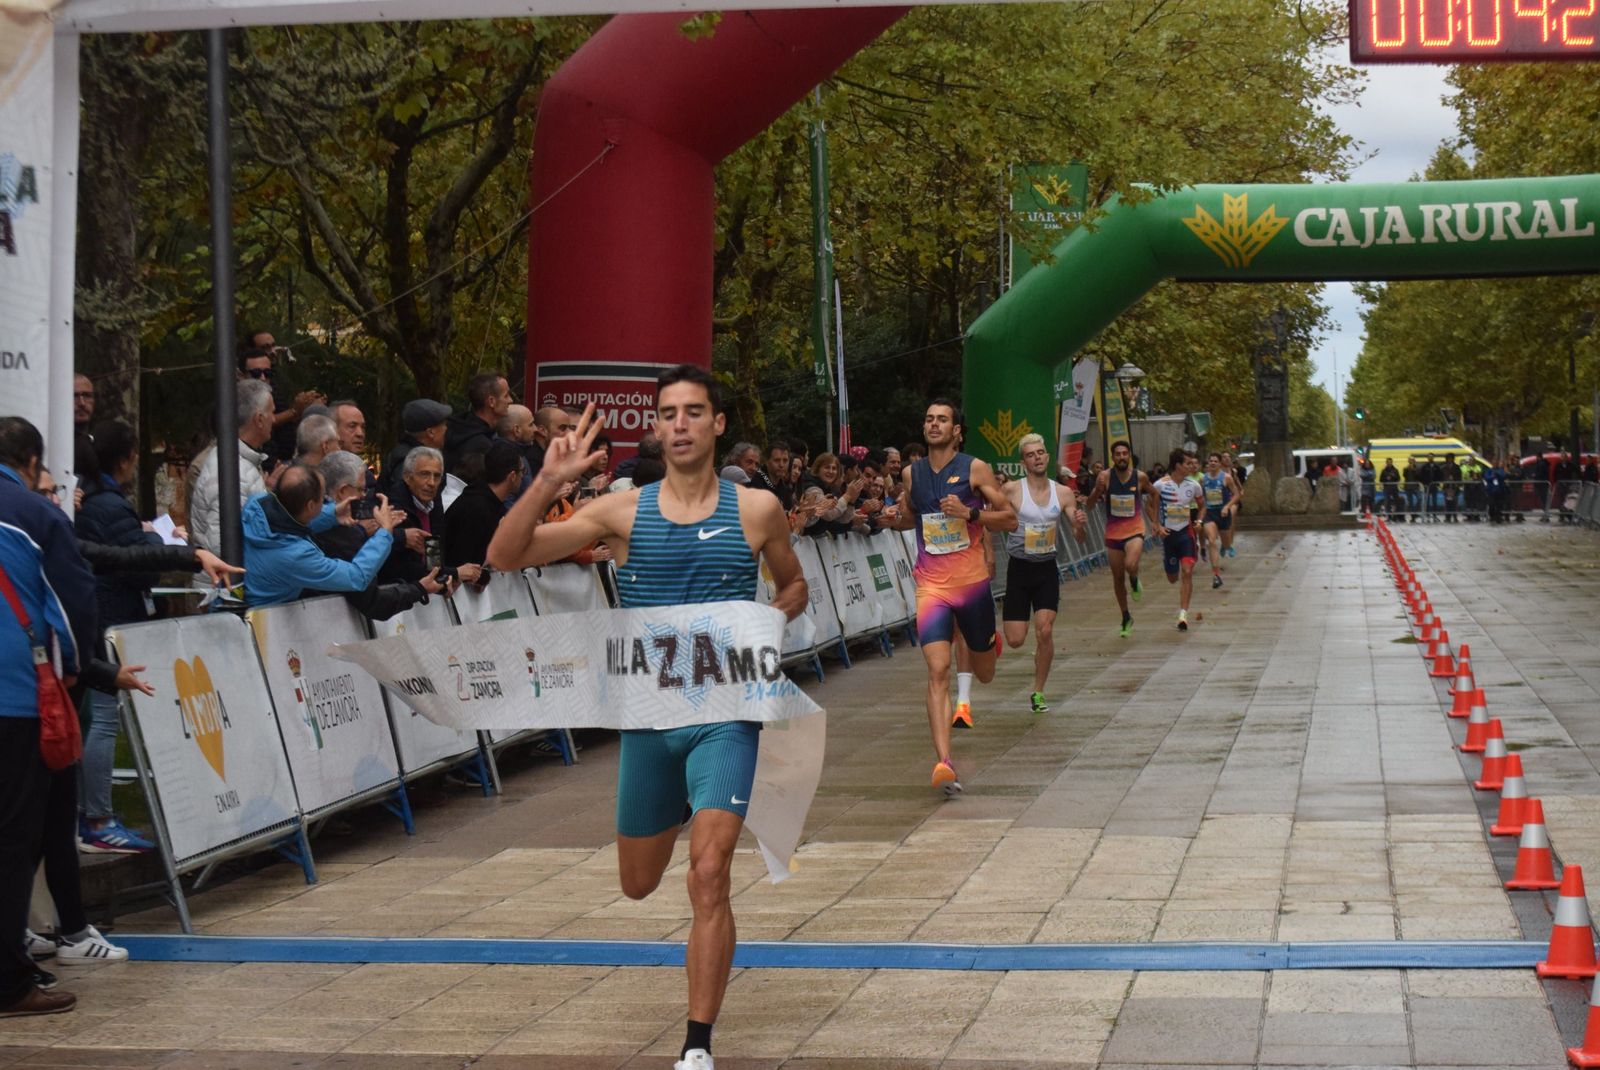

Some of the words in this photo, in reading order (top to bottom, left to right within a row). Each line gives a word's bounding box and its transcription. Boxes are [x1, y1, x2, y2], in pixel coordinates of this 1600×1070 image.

[1294, 205, 1416, 249] CAJA
[1418, 197, 1596, 243] RURAL
[562, 391, 653, 406] DIPUTACIÓN
[597, 408, 657, 430] MOR
[997, 462, 1028, 477] RUR
[653, 632, 782, 691] ZAMO
[311, 673, 355, 701] AYUNTAMIENTO
[315, 702, 331, 730] DE
[327, 695, 363, 727] ZAMORA
